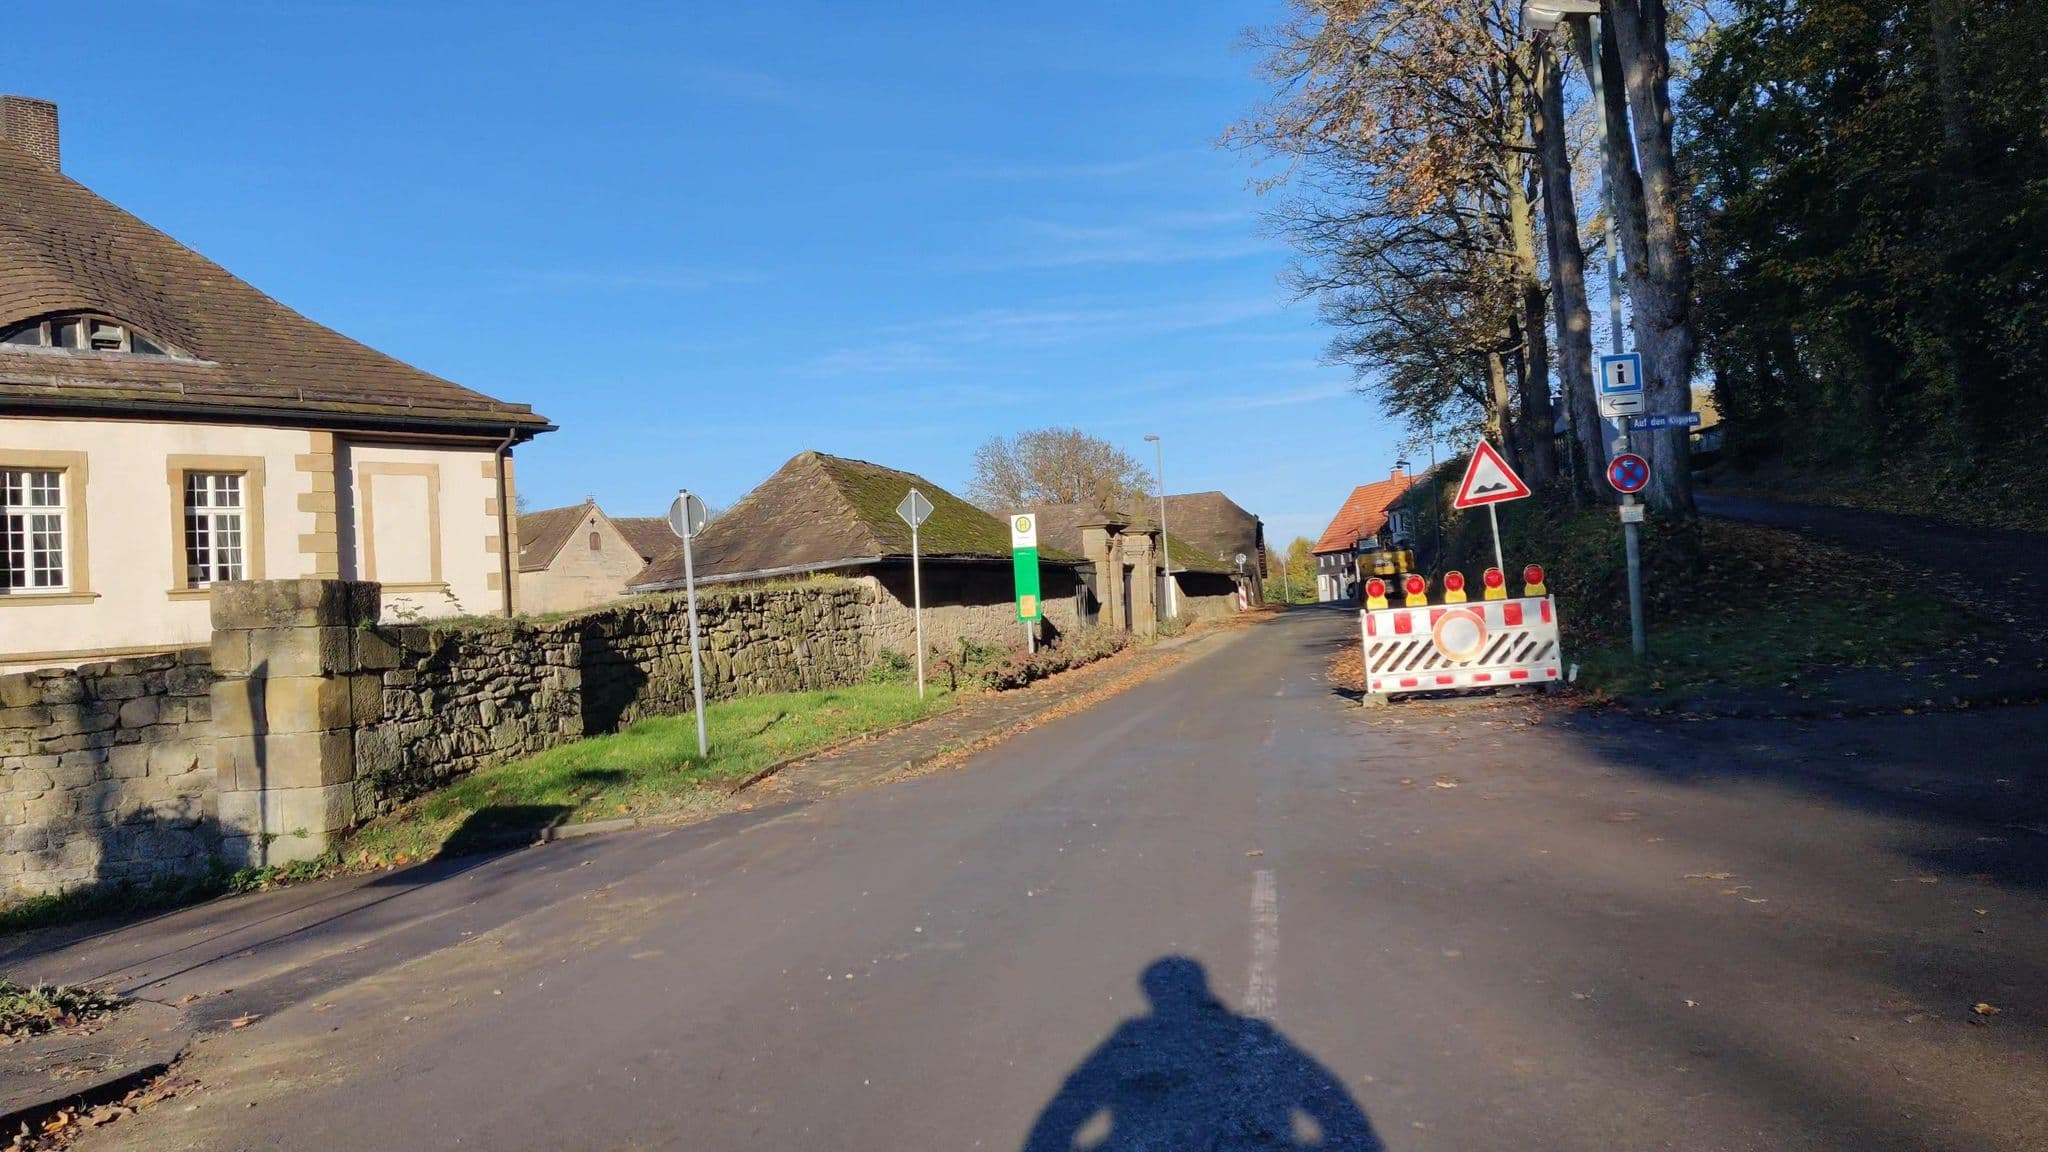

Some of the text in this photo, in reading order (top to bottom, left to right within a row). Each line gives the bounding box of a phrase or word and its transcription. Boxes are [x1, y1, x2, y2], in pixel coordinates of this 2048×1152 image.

[1634, 418, 1647, 428] Auf
[1651, 416, 1665, 426] den
[1020, 520, 1026, 528] H
